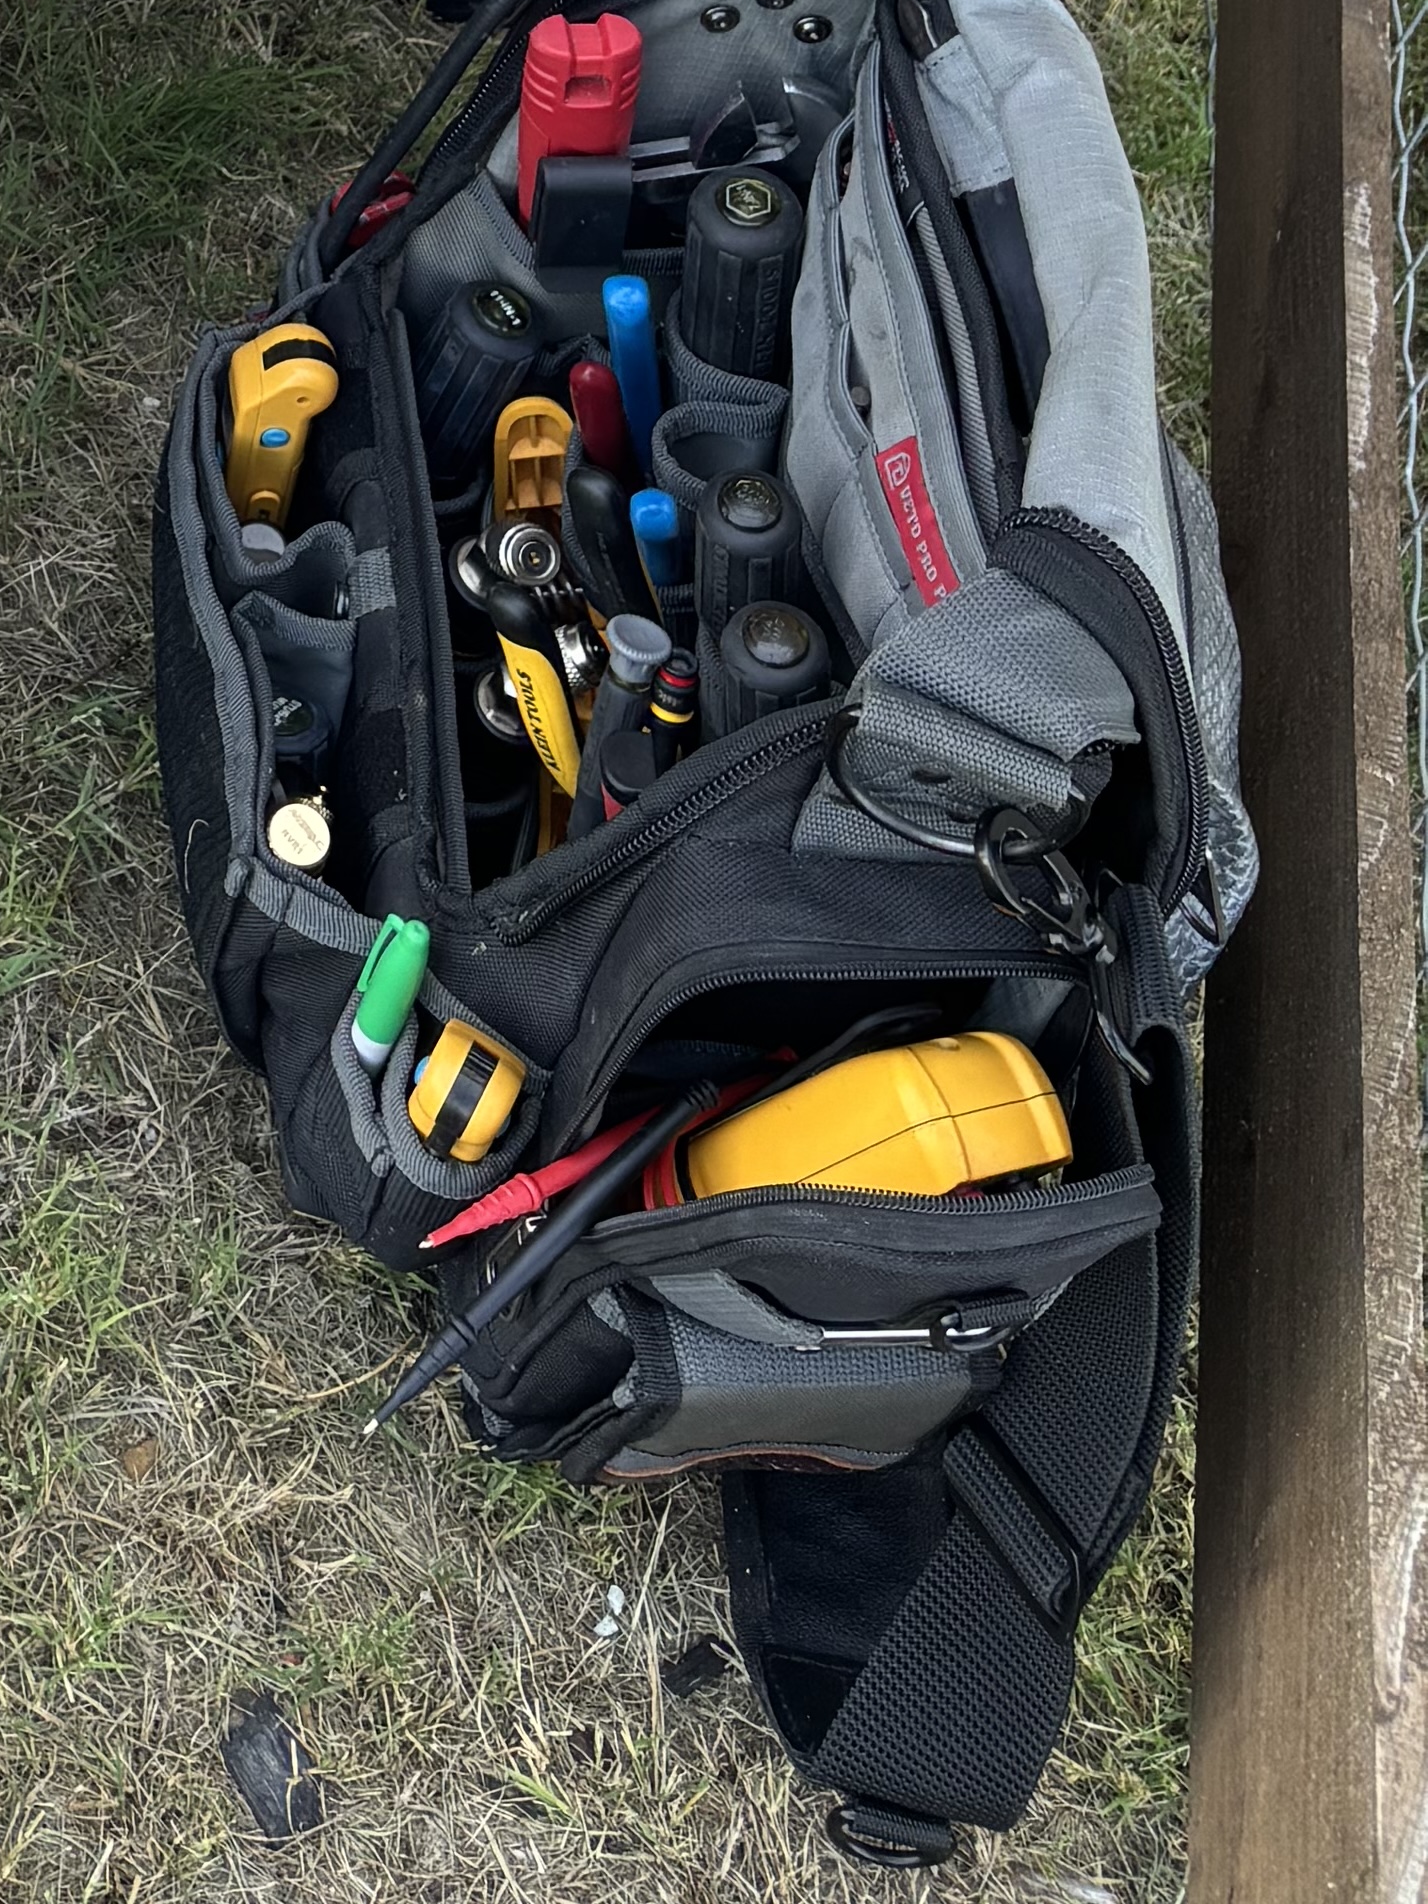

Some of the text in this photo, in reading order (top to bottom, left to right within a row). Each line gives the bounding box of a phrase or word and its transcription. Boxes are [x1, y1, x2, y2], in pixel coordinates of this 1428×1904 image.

[900, 484, 922, 539] VETO
[916, 540, 938, 583] PRO
[516, 668, 561, 773] KLEIN TOOLS
